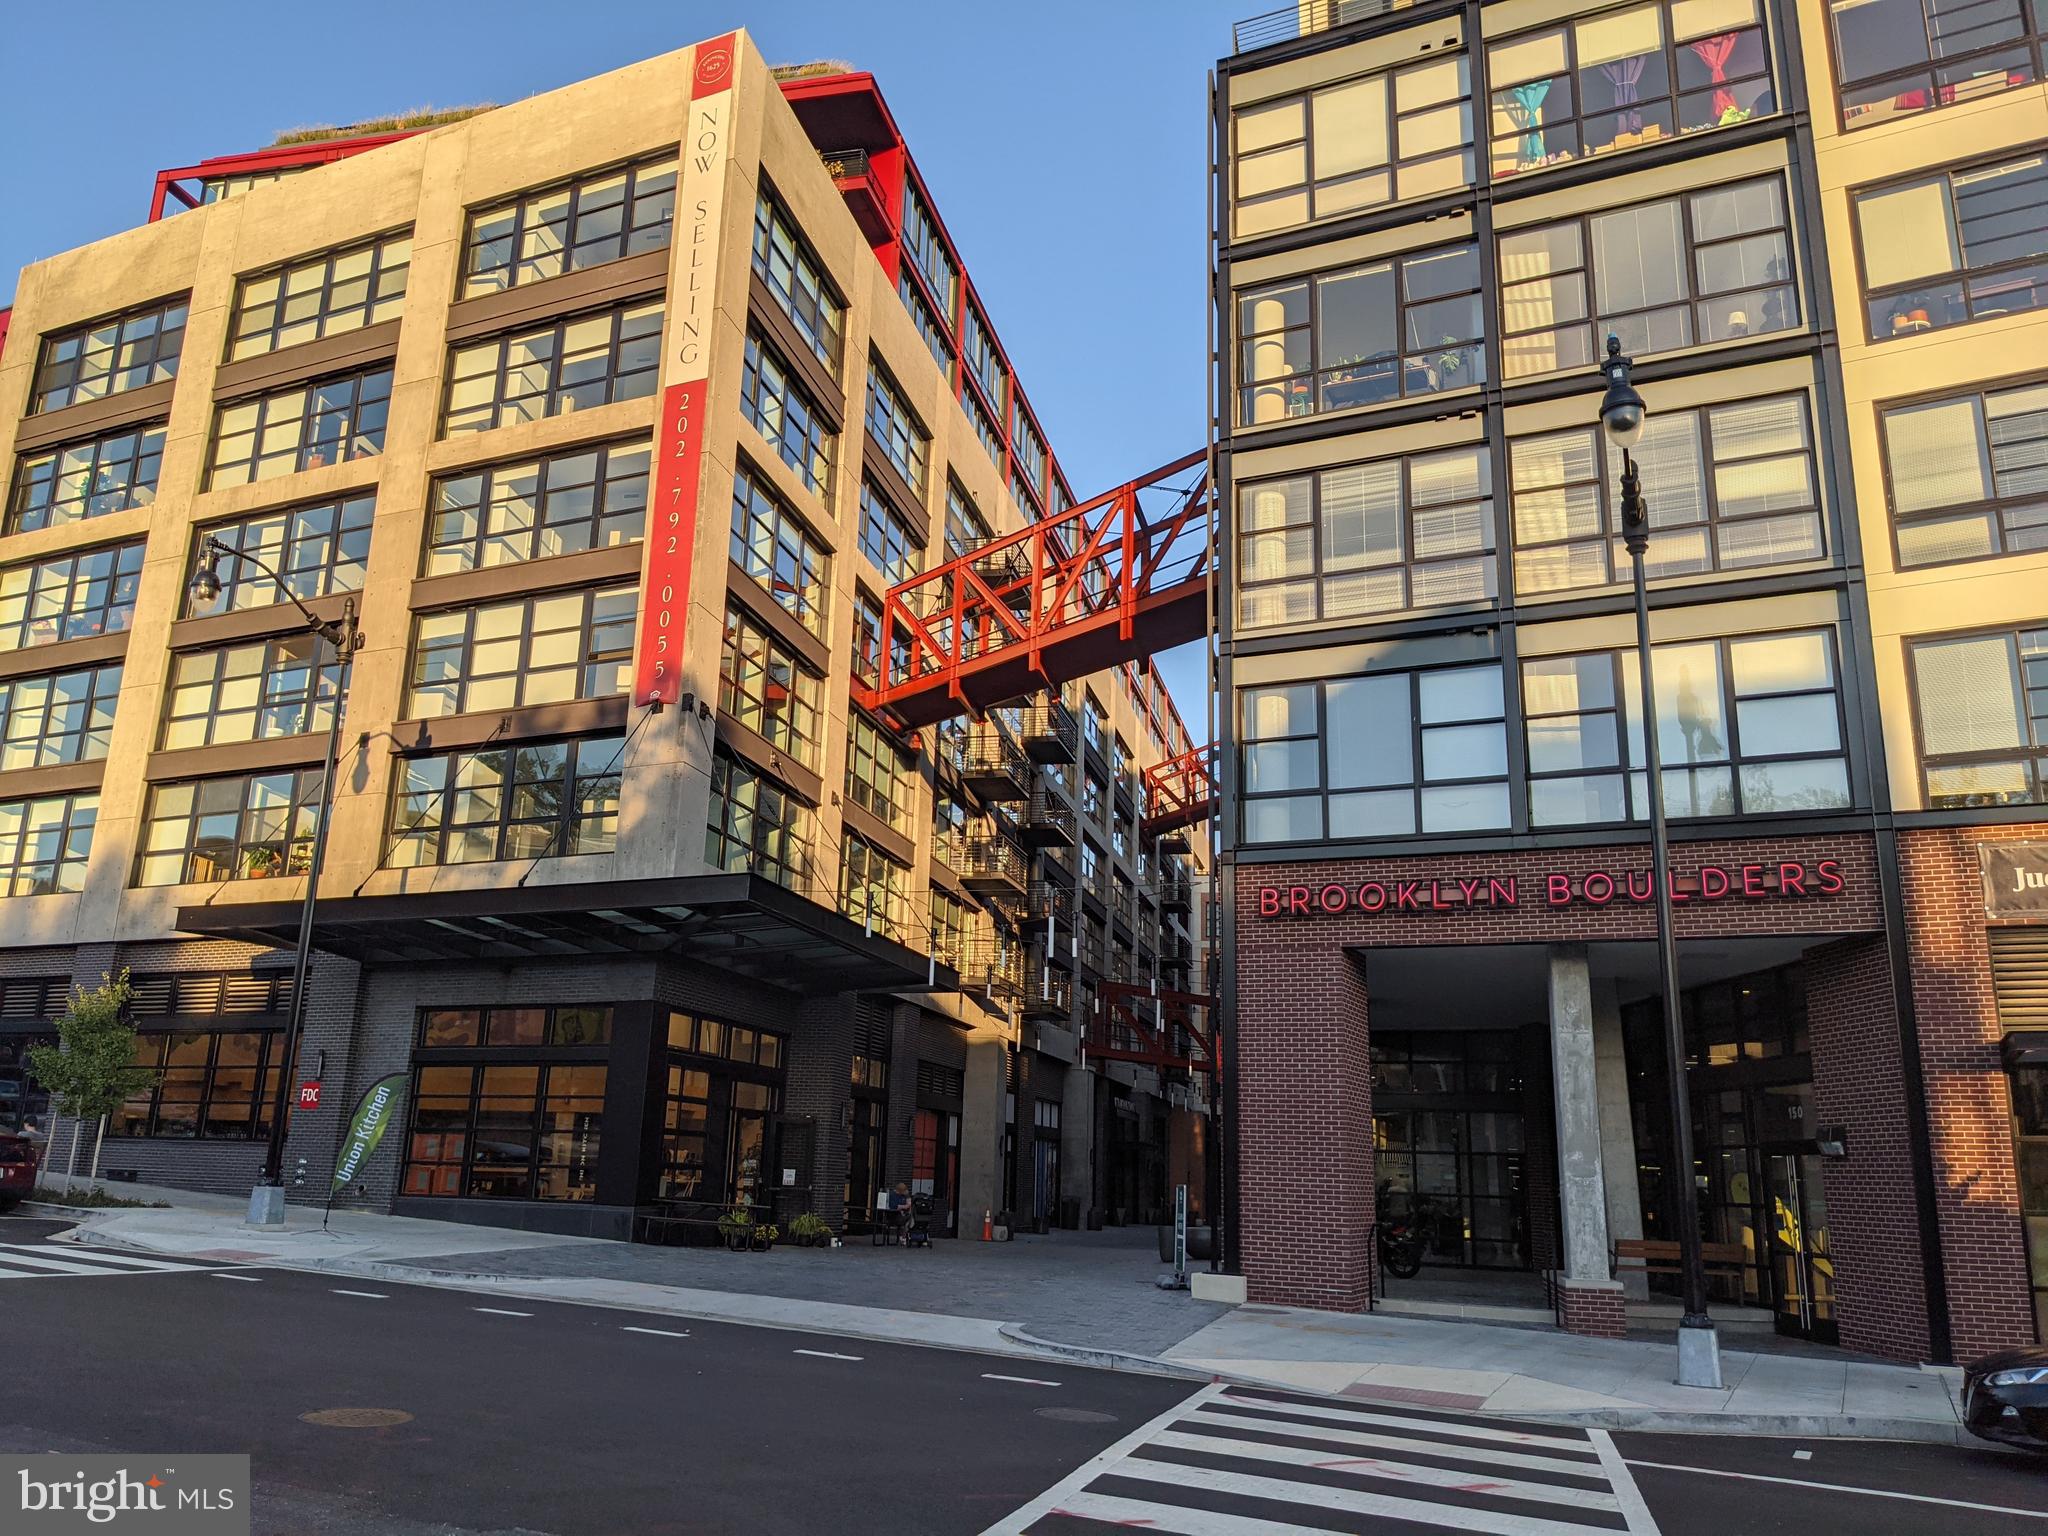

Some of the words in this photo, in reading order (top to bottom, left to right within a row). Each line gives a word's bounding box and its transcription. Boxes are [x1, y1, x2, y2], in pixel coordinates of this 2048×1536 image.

[695, 107, 719, 176] NOW
[679, 200, 708, 365] SELLING
[1259, 875, 1518, 917] BROOKLYN
[1547, 859, 1845, 904] BOULDERS
[2012, 867, 2048, 892] Ju
[301, 1088, 319, 1102] FDC
[1788, 1105, 1803, 1120] 150
[336, 1143, 366, 1182] Union
[355, 1086, 391, 1140] Kitchen
